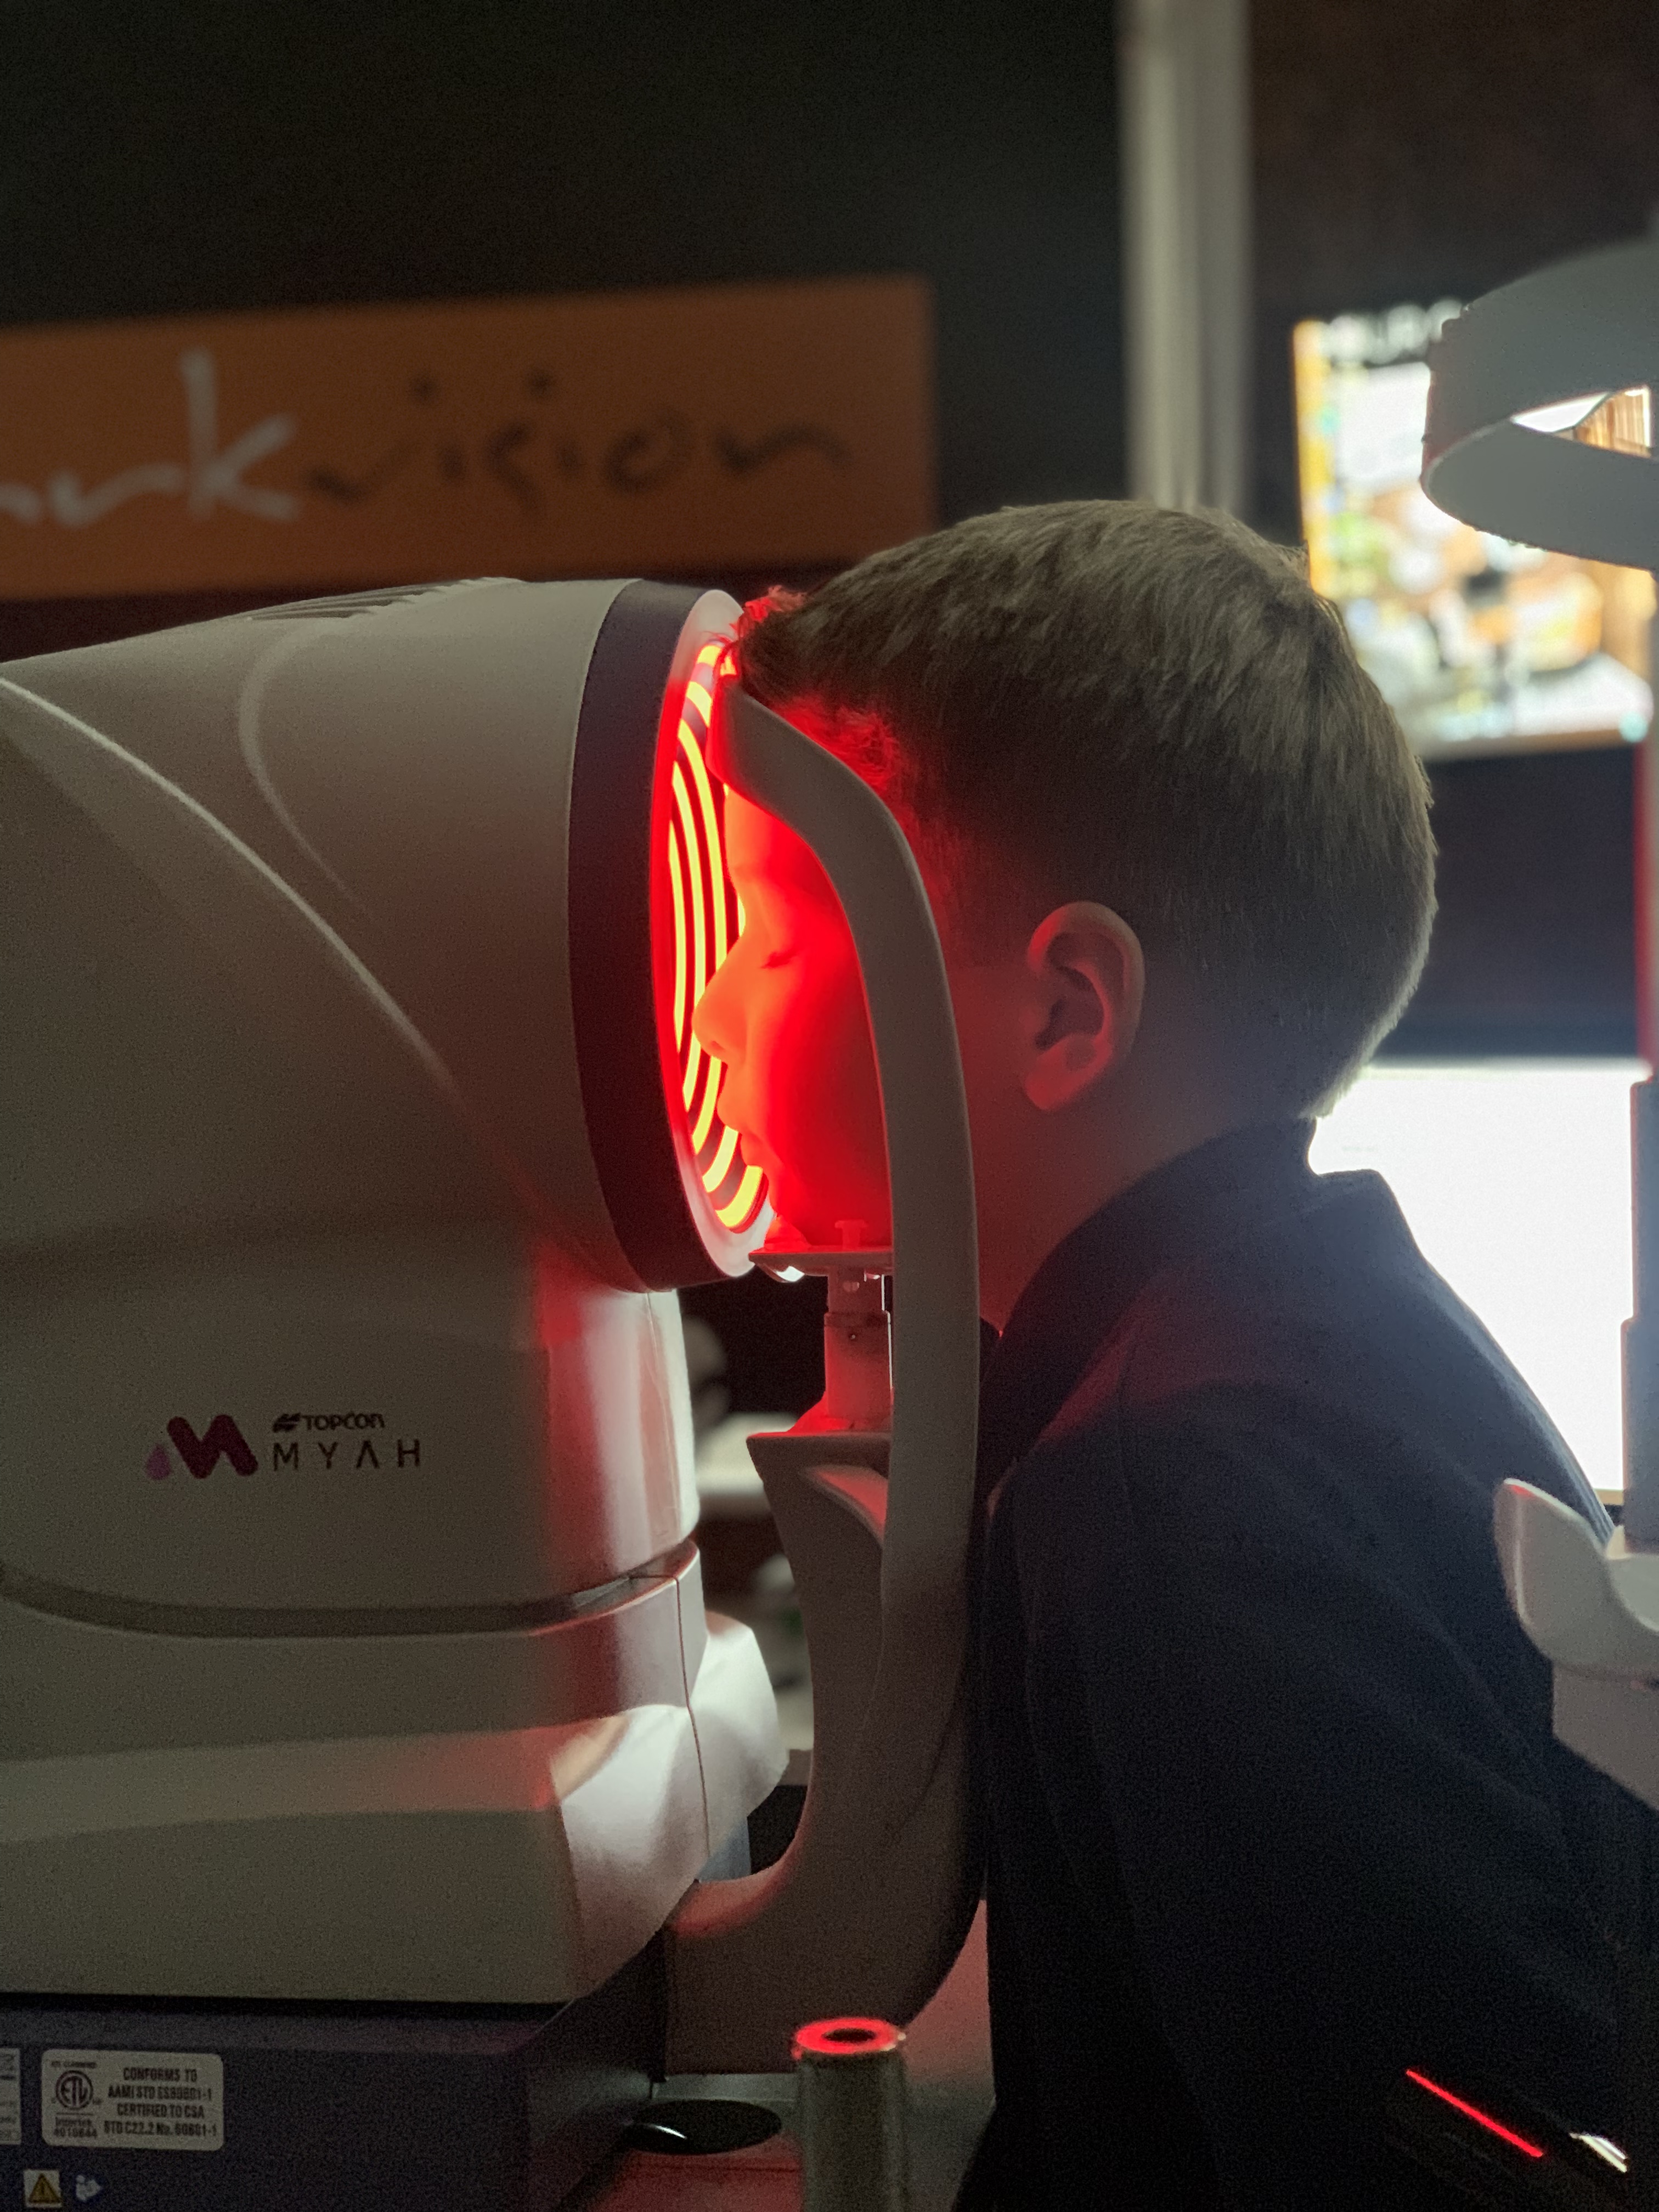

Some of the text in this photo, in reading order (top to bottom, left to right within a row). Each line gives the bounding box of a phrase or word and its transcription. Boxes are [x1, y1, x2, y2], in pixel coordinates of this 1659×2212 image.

[273, 1439, 420, 1471] MYAH
[123, 2067, 198, 2082] CONFORMS TO
[108, 2084, 134, 2098] AAMI
[136, 2085, 155, 2100] STD
[116, 2103, 205, 2119] CERTIFIED TO CSA
[104, 2120, 123, 2134] STD
[125, 2121, 154, 2135] C22.2
